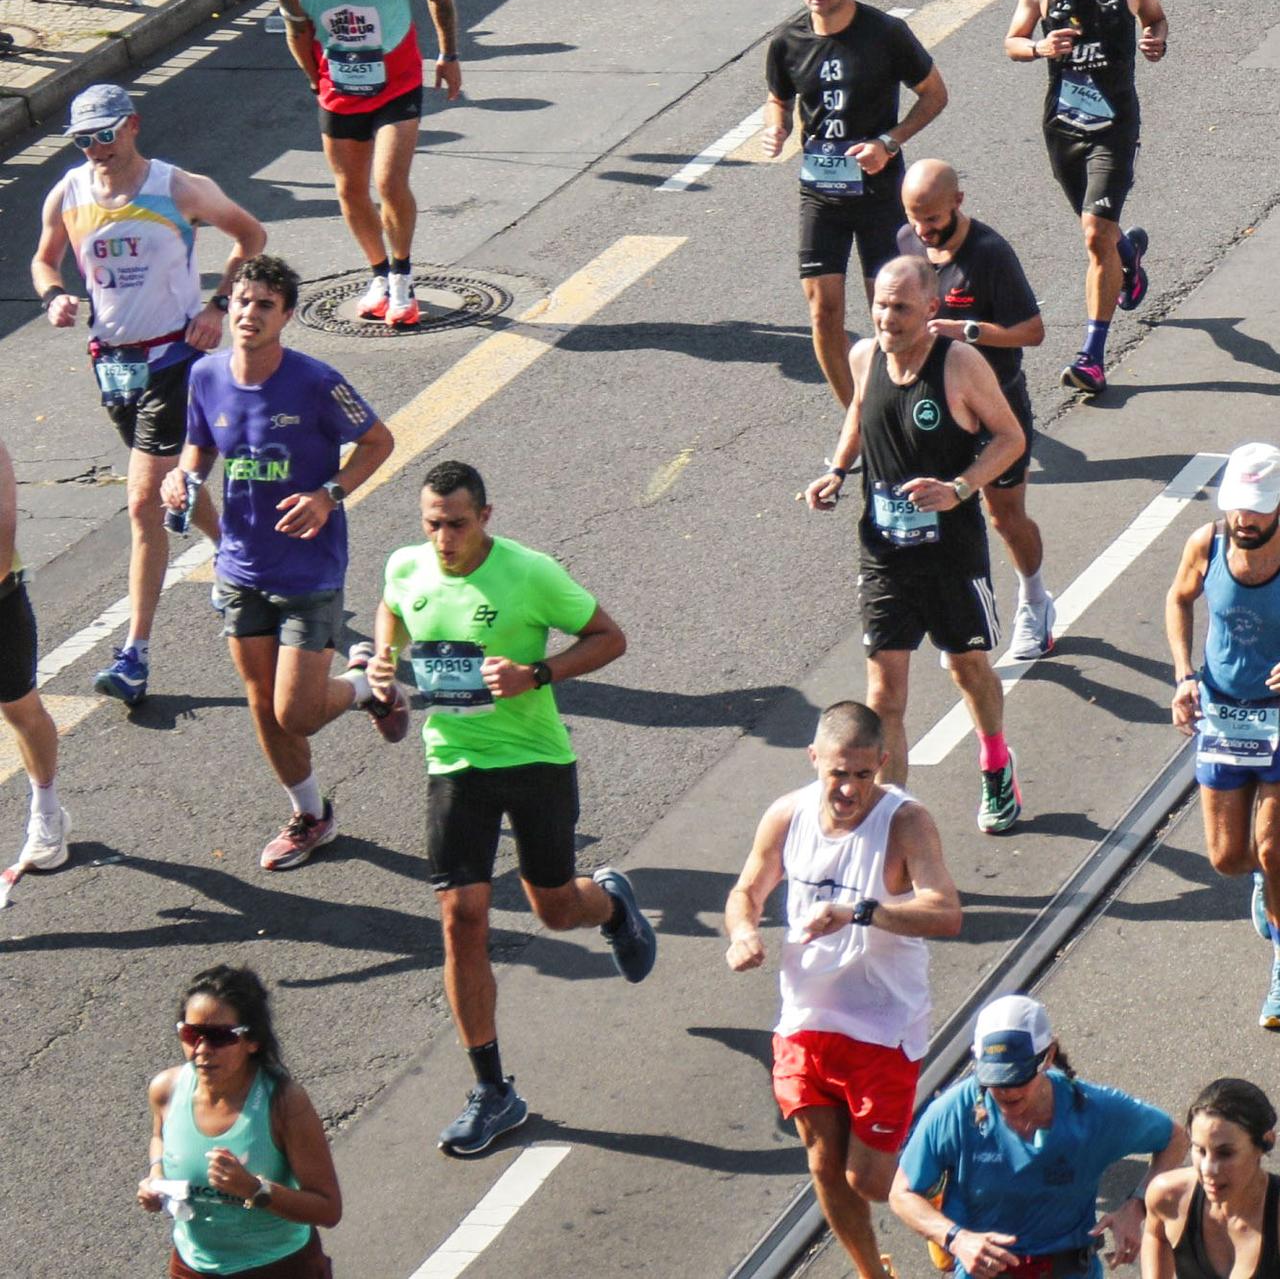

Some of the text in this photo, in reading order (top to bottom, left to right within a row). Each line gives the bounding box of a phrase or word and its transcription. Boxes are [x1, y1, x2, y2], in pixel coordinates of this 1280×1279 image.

[339, 63, 373, 73] 22451
[820, 59, 842, 82] 43
[823, 90, 843, 111] 50
[825, 119, 845, 139] 20
[813, 156, 848, 169] 72371
[93, 237, 141, 258] GUY
[224, 458, 290, 481] BERLIN
[425, 658, 473, 673] 50819
[1219, 706, 1267, 723] 84950
[1220, 739, 1260, 751] zalando
